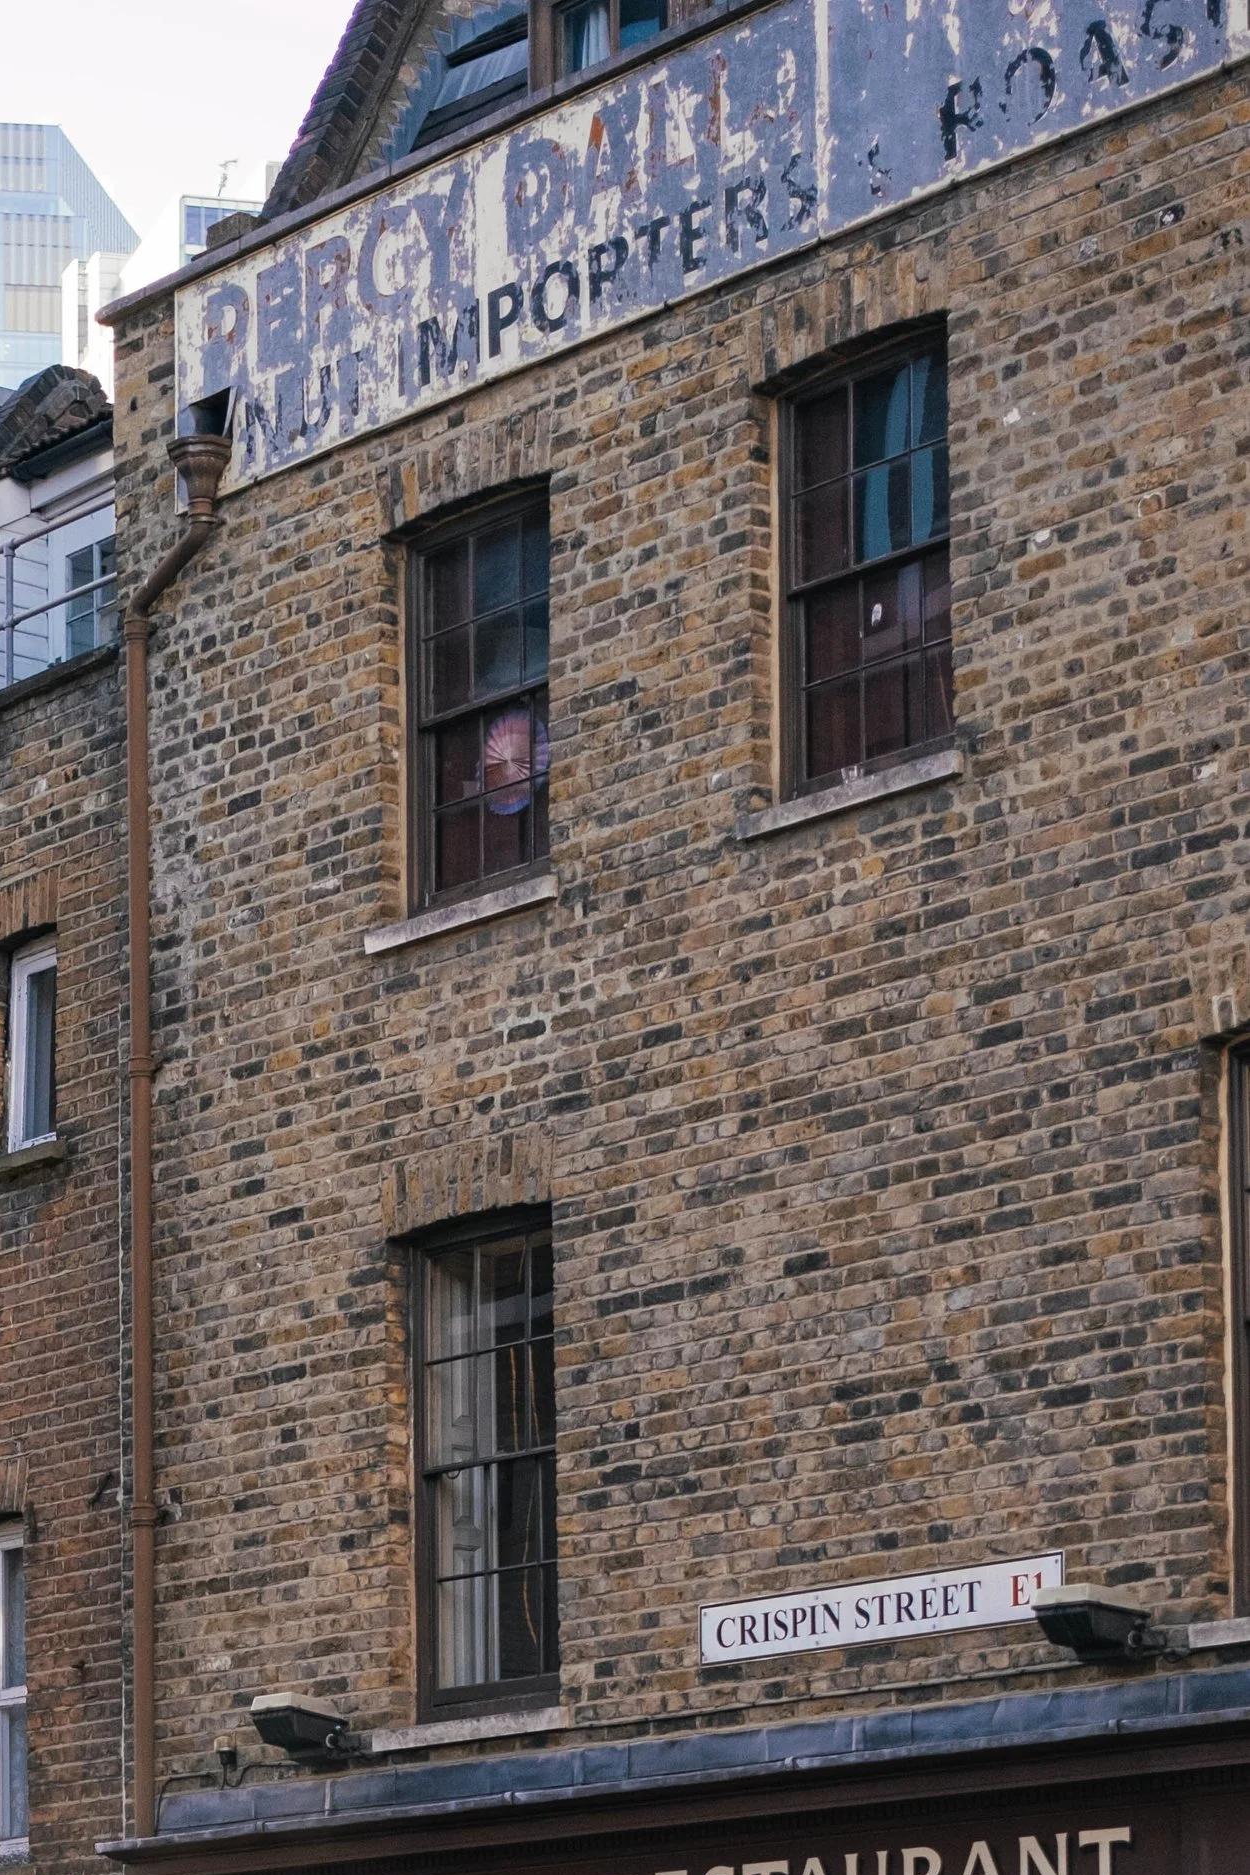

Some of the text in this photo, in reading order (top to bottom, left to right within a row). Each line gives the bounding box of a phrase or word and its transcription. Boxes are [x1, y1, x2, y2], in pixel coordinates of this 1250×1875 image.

[397, 152, 818, 400] IMPORTERS
[715, 1601, 842, 1649] CRISPIN
[854, 1580, 982, 1630] STREET
